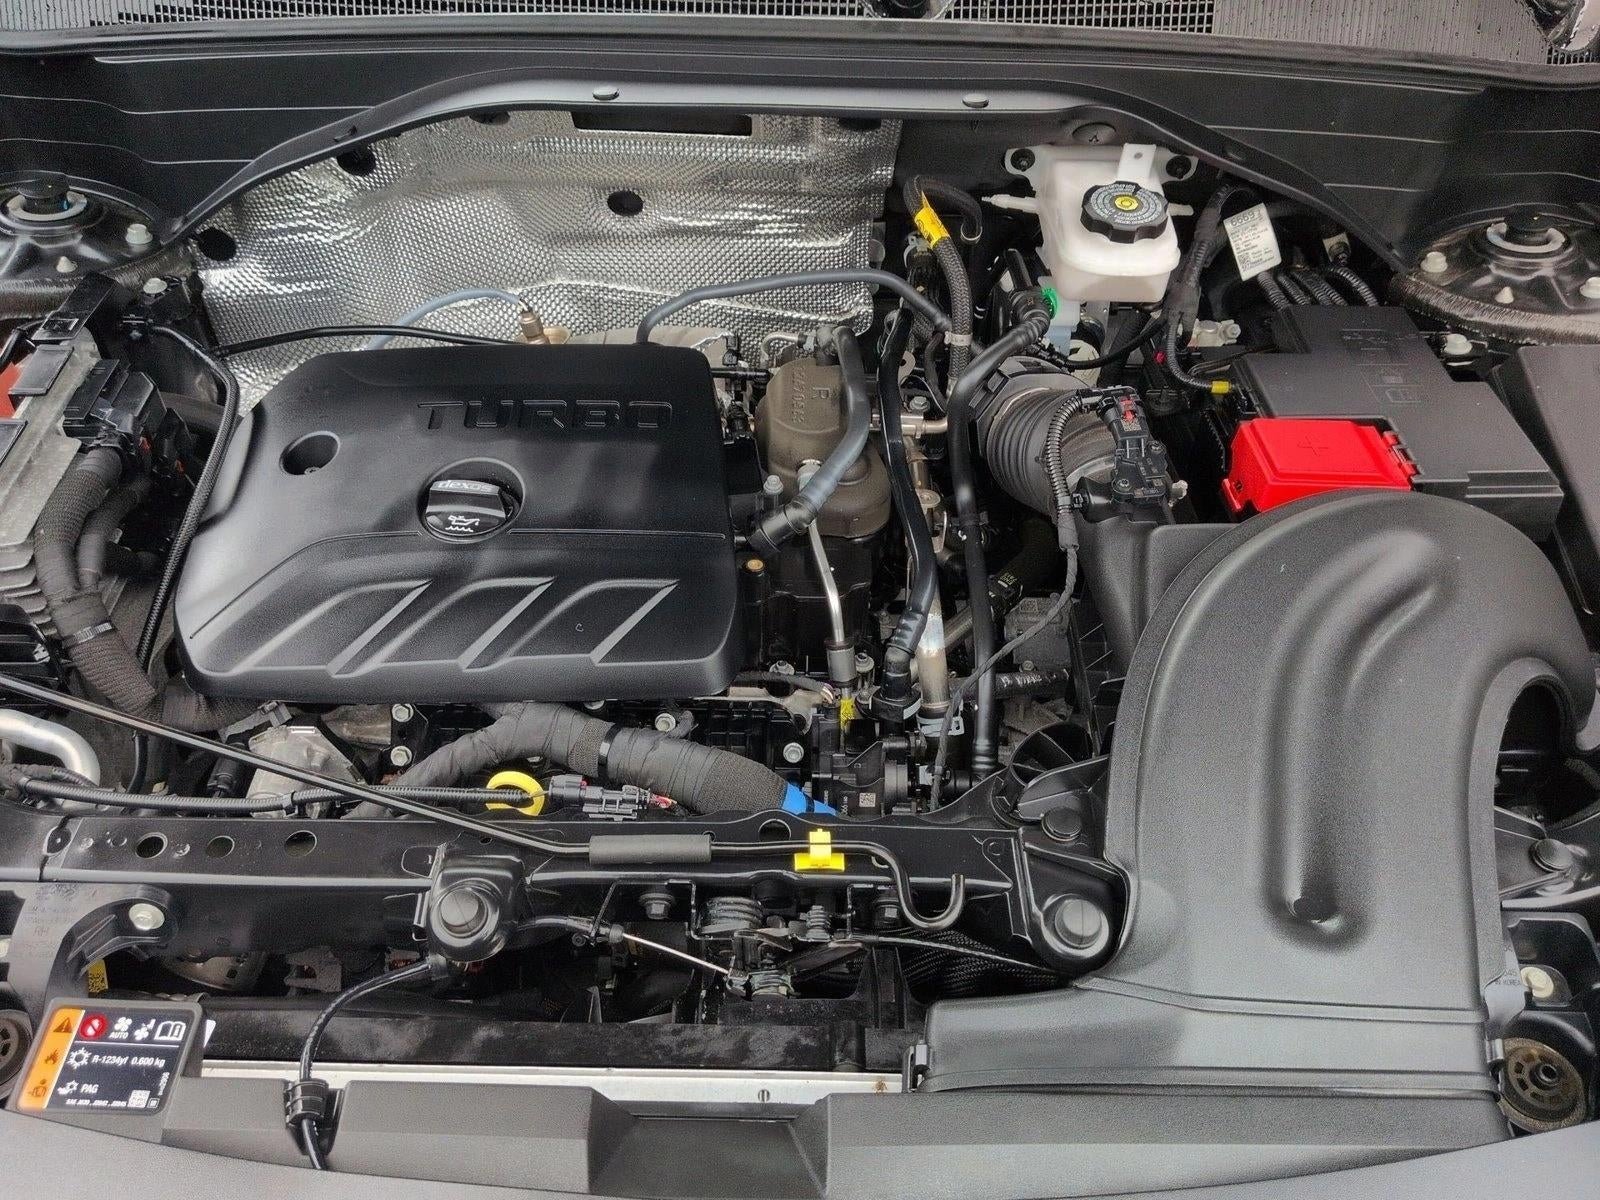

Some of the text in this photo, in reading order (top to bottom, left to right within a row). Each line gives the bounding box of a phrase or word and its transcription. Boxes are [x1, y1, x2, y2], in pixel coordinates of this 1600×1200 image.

[418, 400, 673, 429] TURBO
[438, 479, 495, 493] dexos
[108, 1031, 129, 1039] AUTO
[91, 1054, 166, 1068] R-1234yf 0.600 kg
[80, 1083, 99, 1094] PAG
